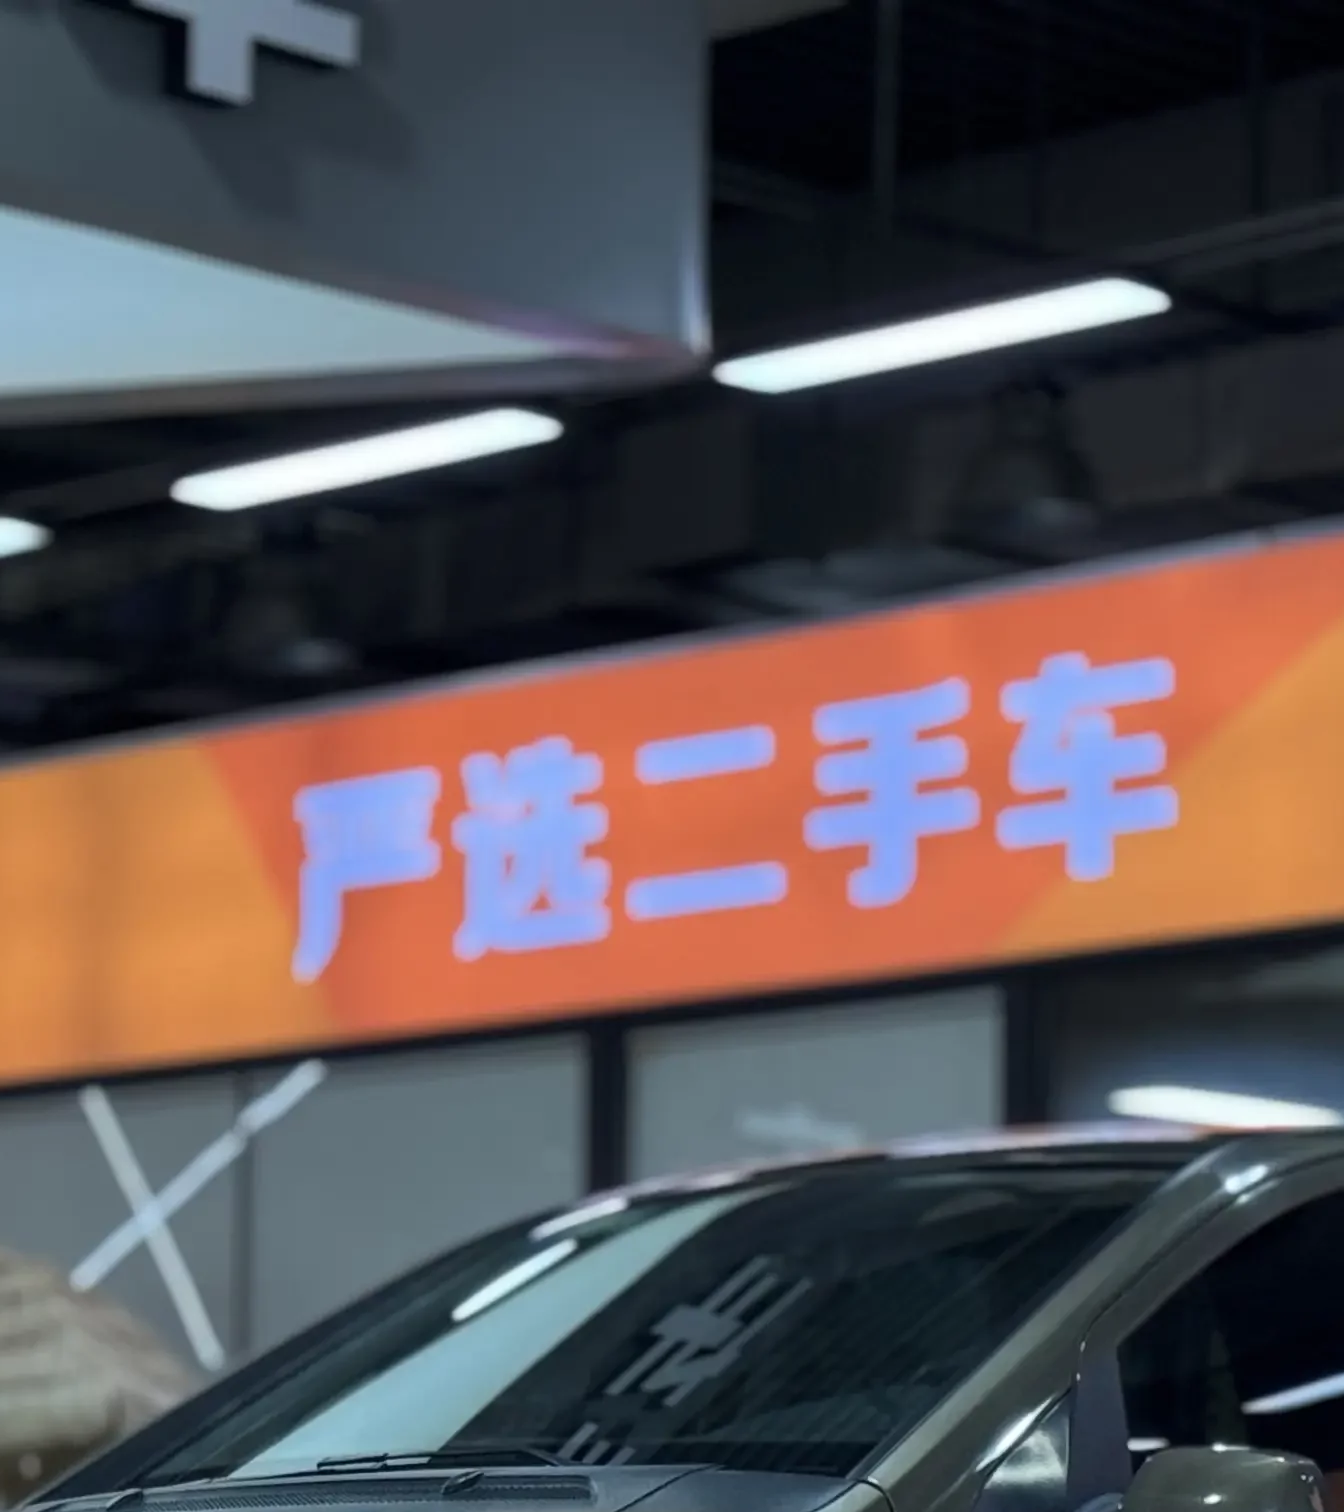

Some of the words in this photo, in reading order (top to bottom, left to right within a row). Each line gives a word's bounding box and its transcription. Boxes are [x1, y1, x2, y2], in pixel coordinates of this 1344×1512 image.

[291, 650, 1179, 984] 严选二手车
